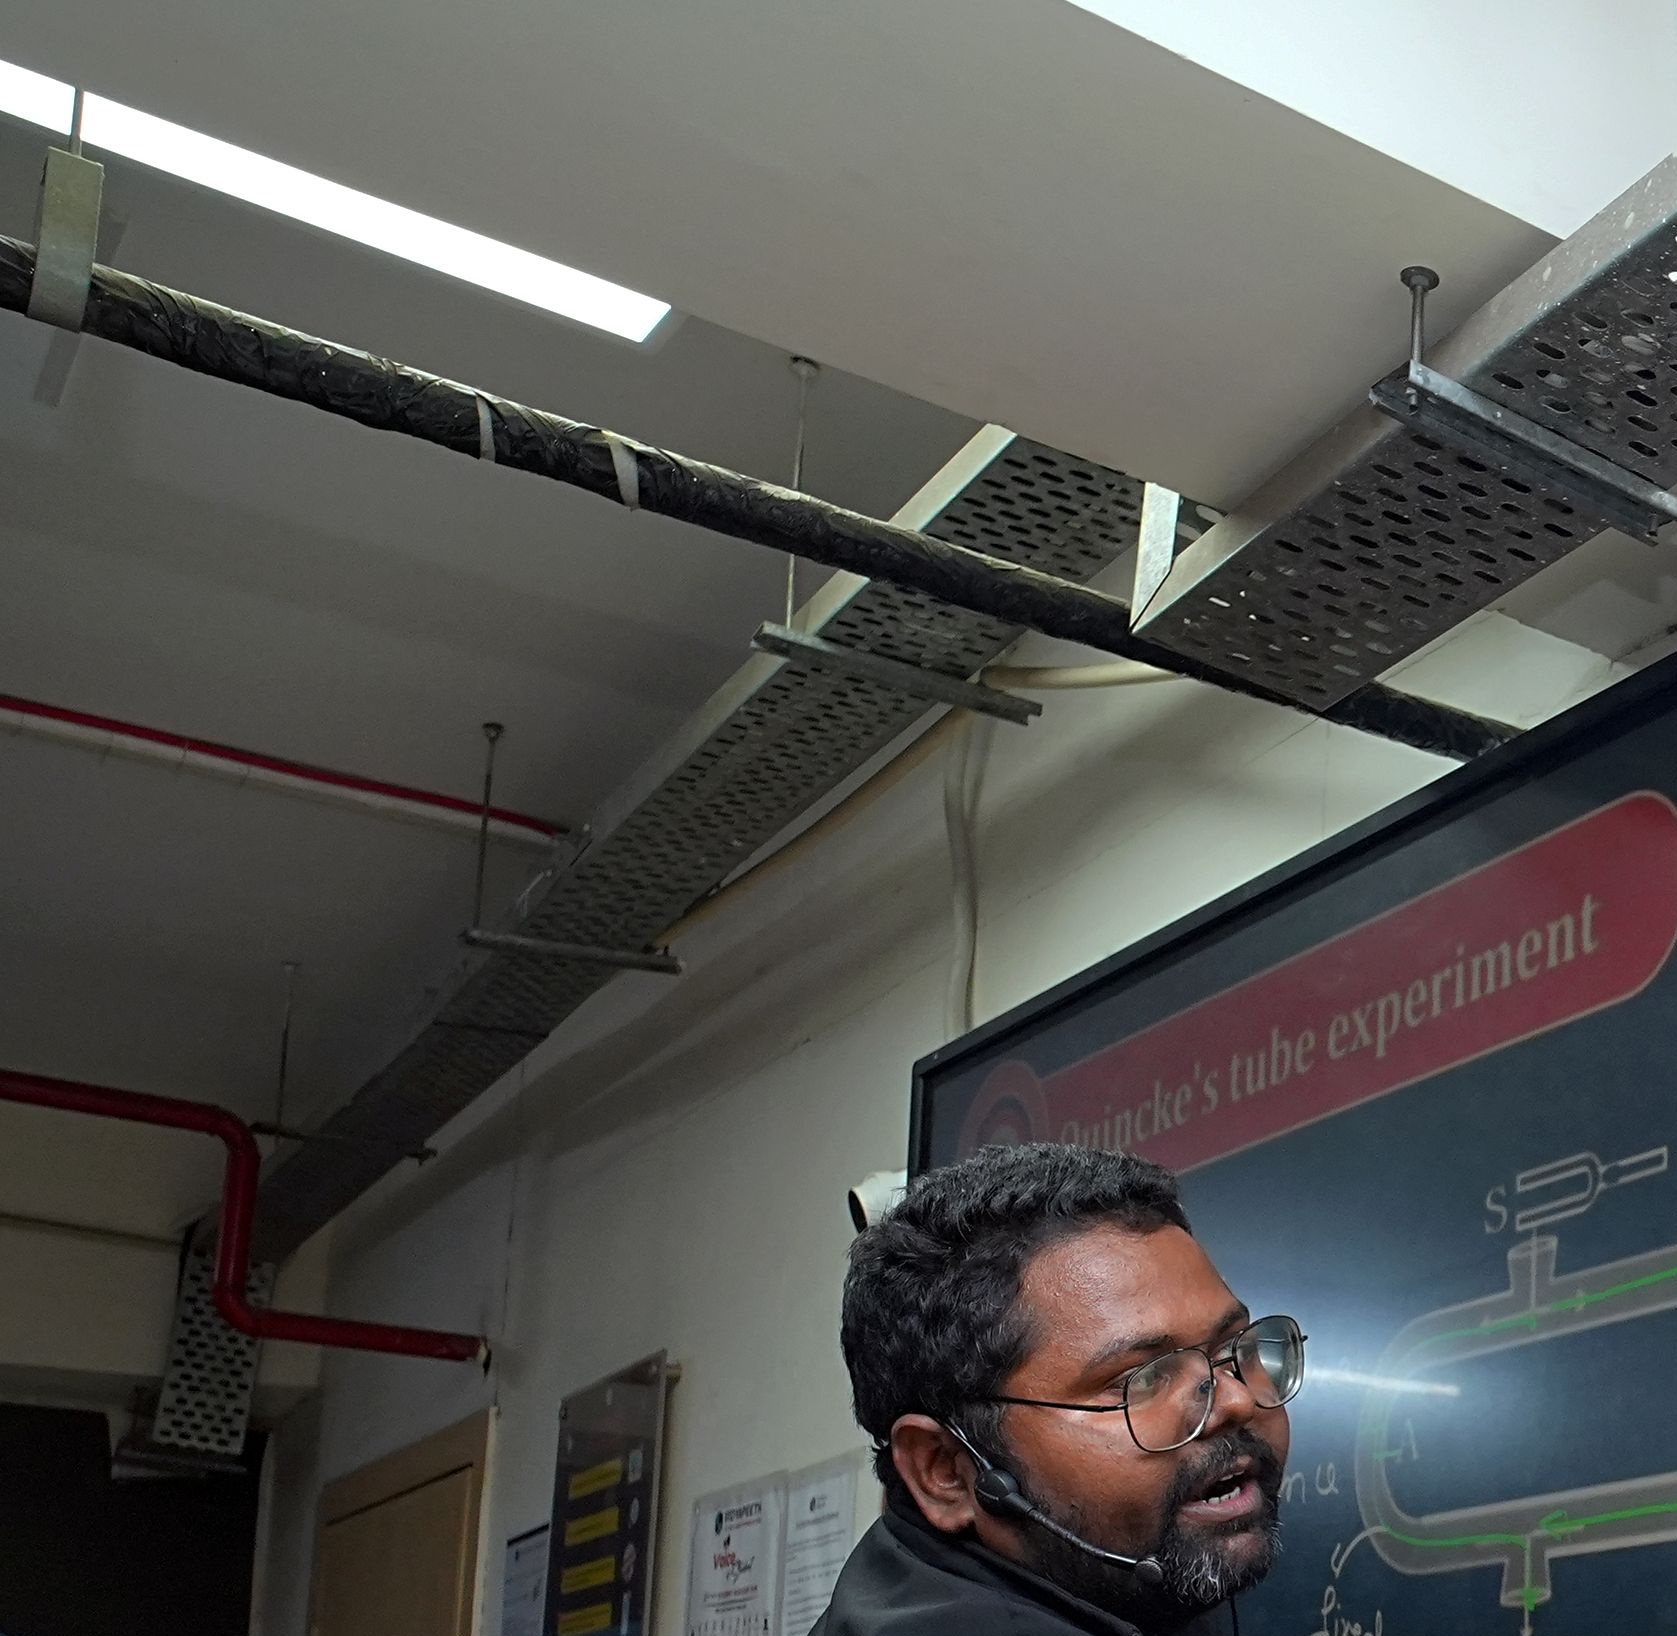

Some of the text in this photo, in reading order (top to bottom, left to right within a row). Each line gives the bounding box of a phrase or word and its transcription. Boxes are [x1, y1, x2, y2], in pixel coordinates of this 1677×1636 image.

[1229, 1025, 1317, 1102] tube
[1327, 893, 1600, 1060] experiment
[1485, 1186, 1508, 1234] S
